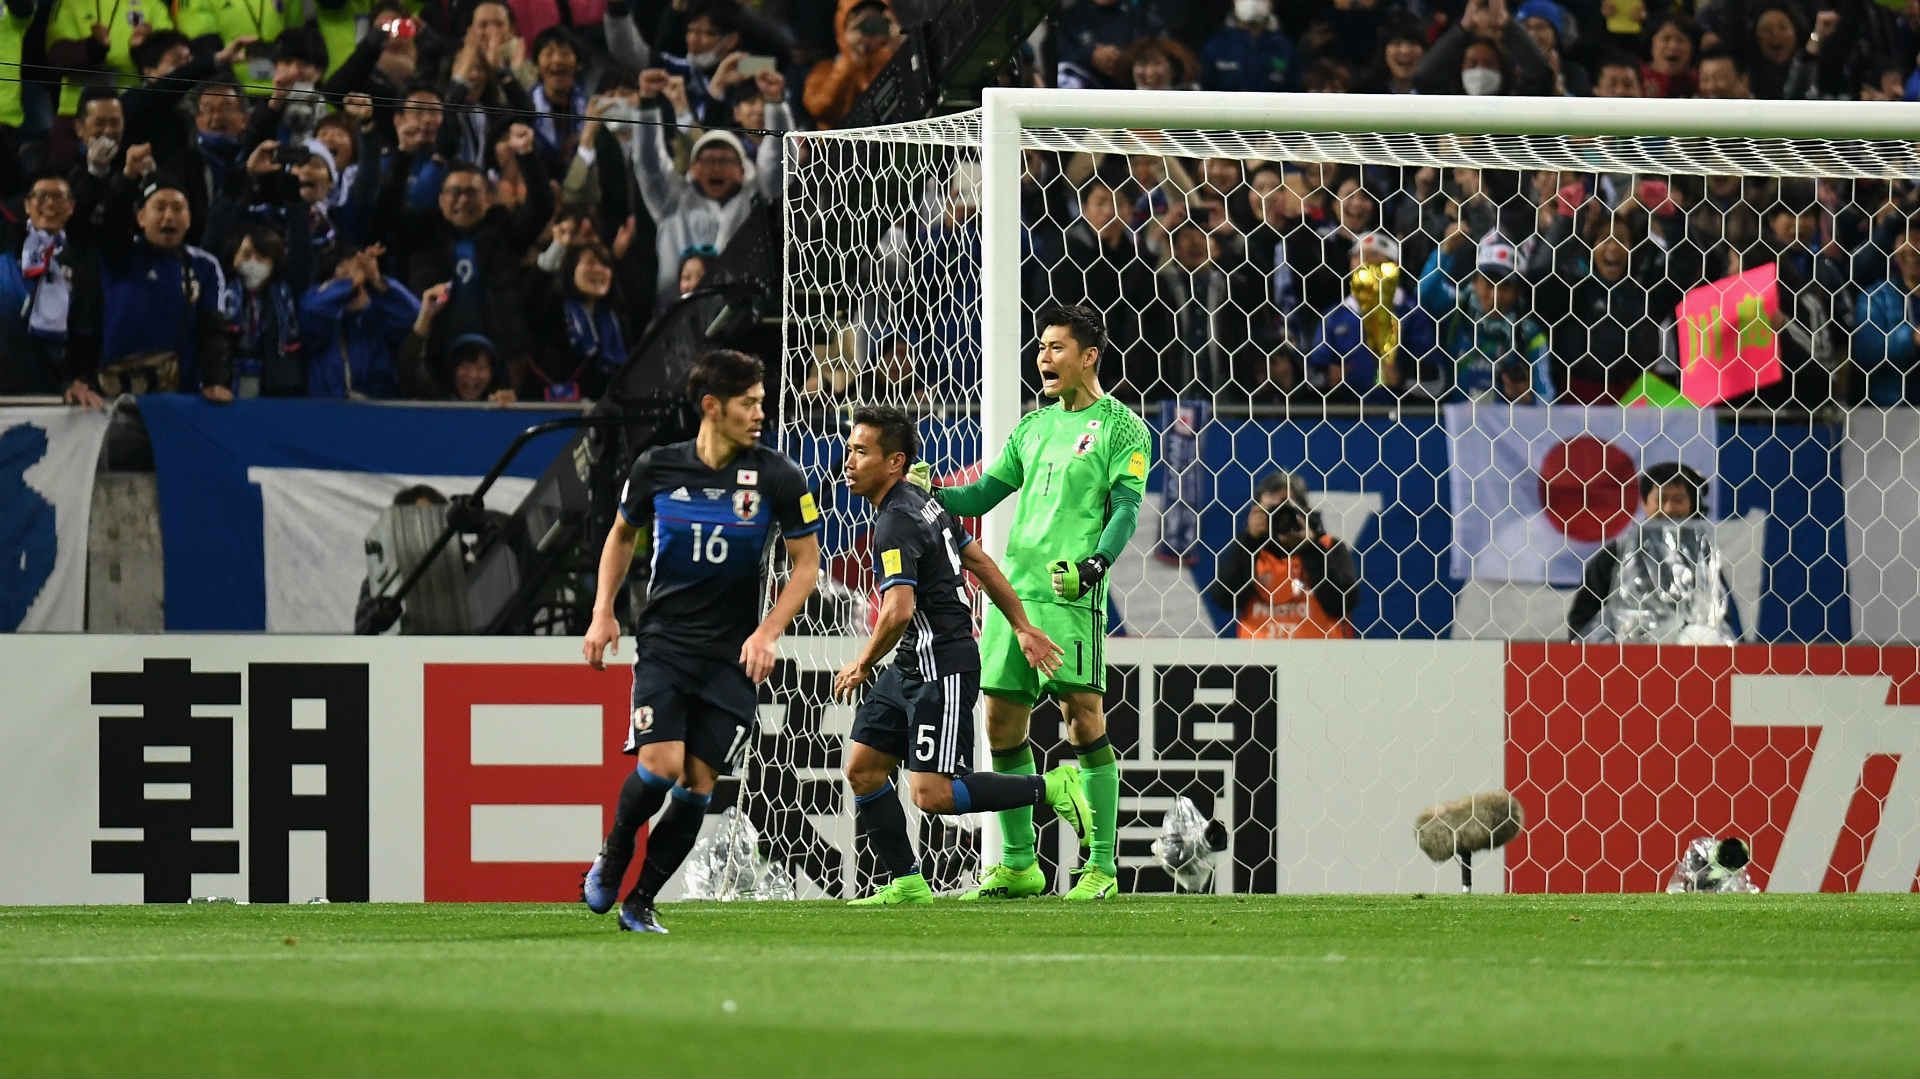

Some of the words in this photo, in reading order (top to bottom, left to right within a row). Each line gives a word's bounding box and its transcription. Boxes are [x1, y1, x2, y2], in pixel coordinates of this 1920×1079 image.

[690, 522, 729, 564] 16
[1074, 640, 1083, 676] 1
[915, 724, 936, 762] 5
